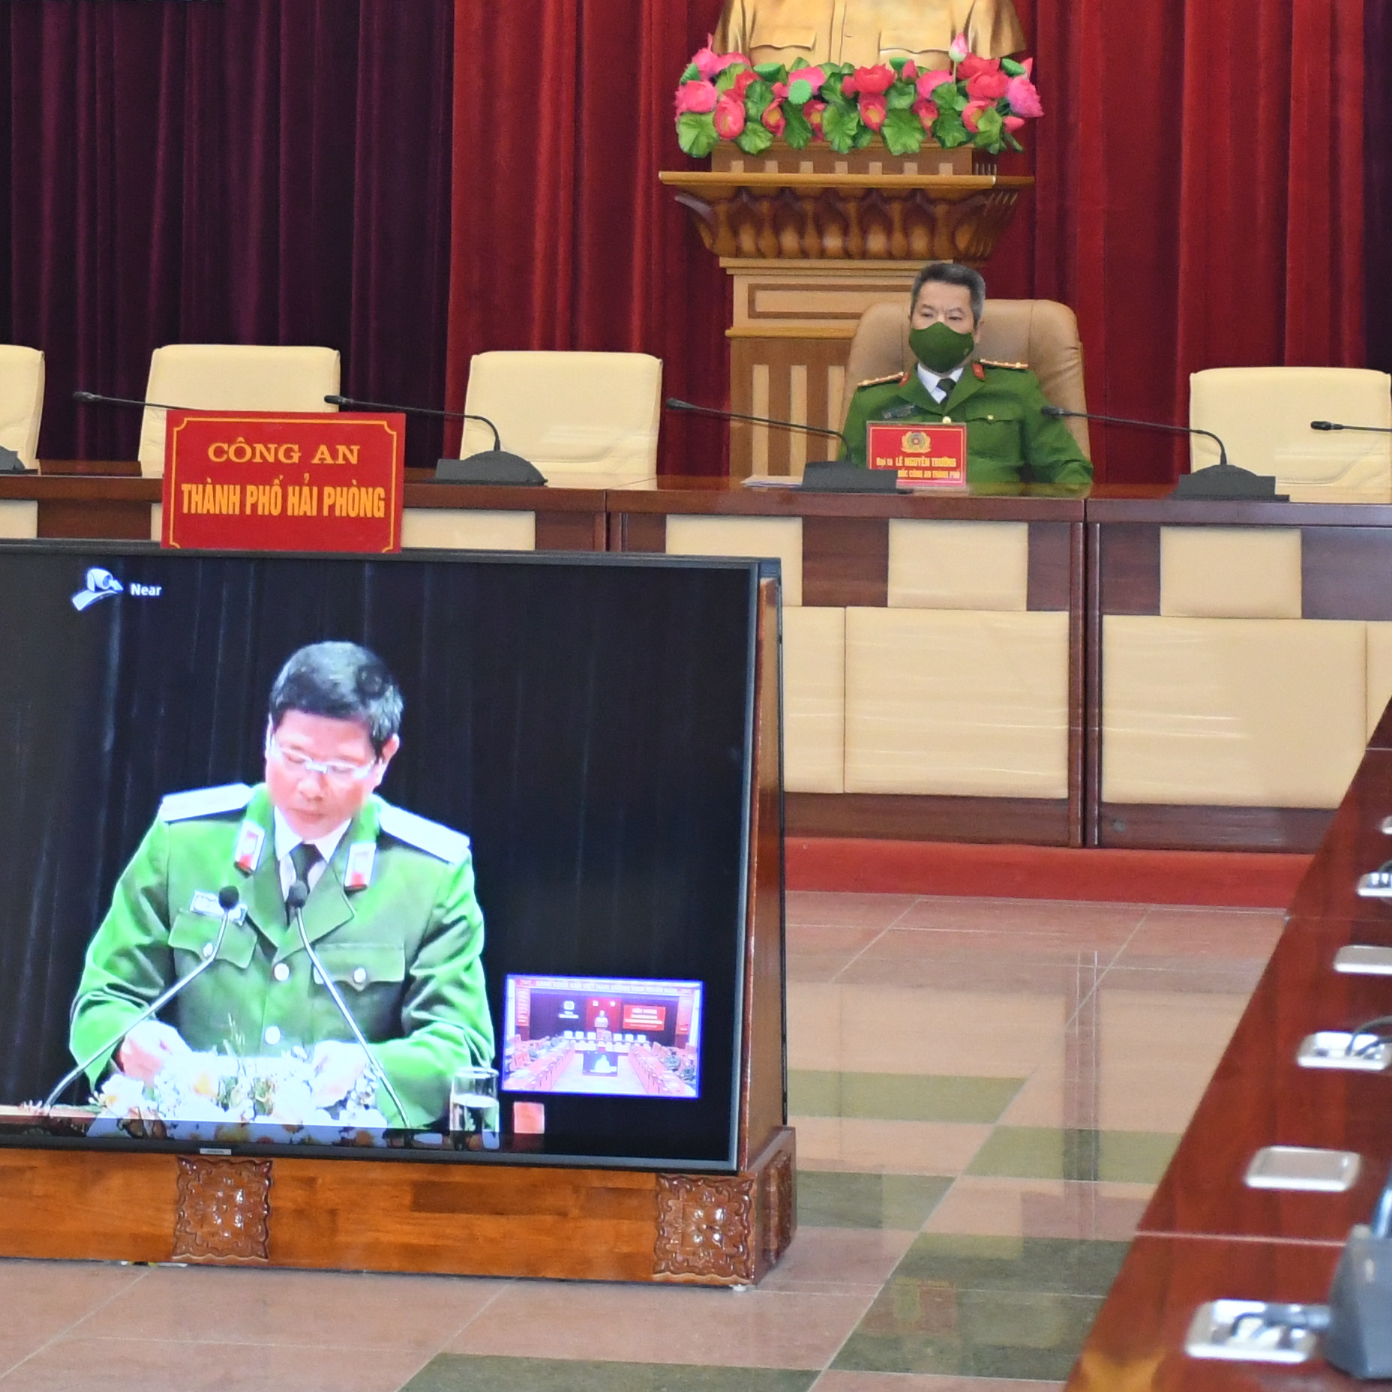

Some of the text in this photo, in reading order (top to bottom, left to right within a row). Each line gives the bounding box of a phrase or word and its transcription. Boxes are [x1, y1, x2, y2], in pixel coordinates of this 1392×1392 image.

[208, 437, 360, 464] CÔNG AN
[182, 473, 385, 517] THÀNH PHỐ HẢI PHÒNG
[130, 584, 162, 596] Near
